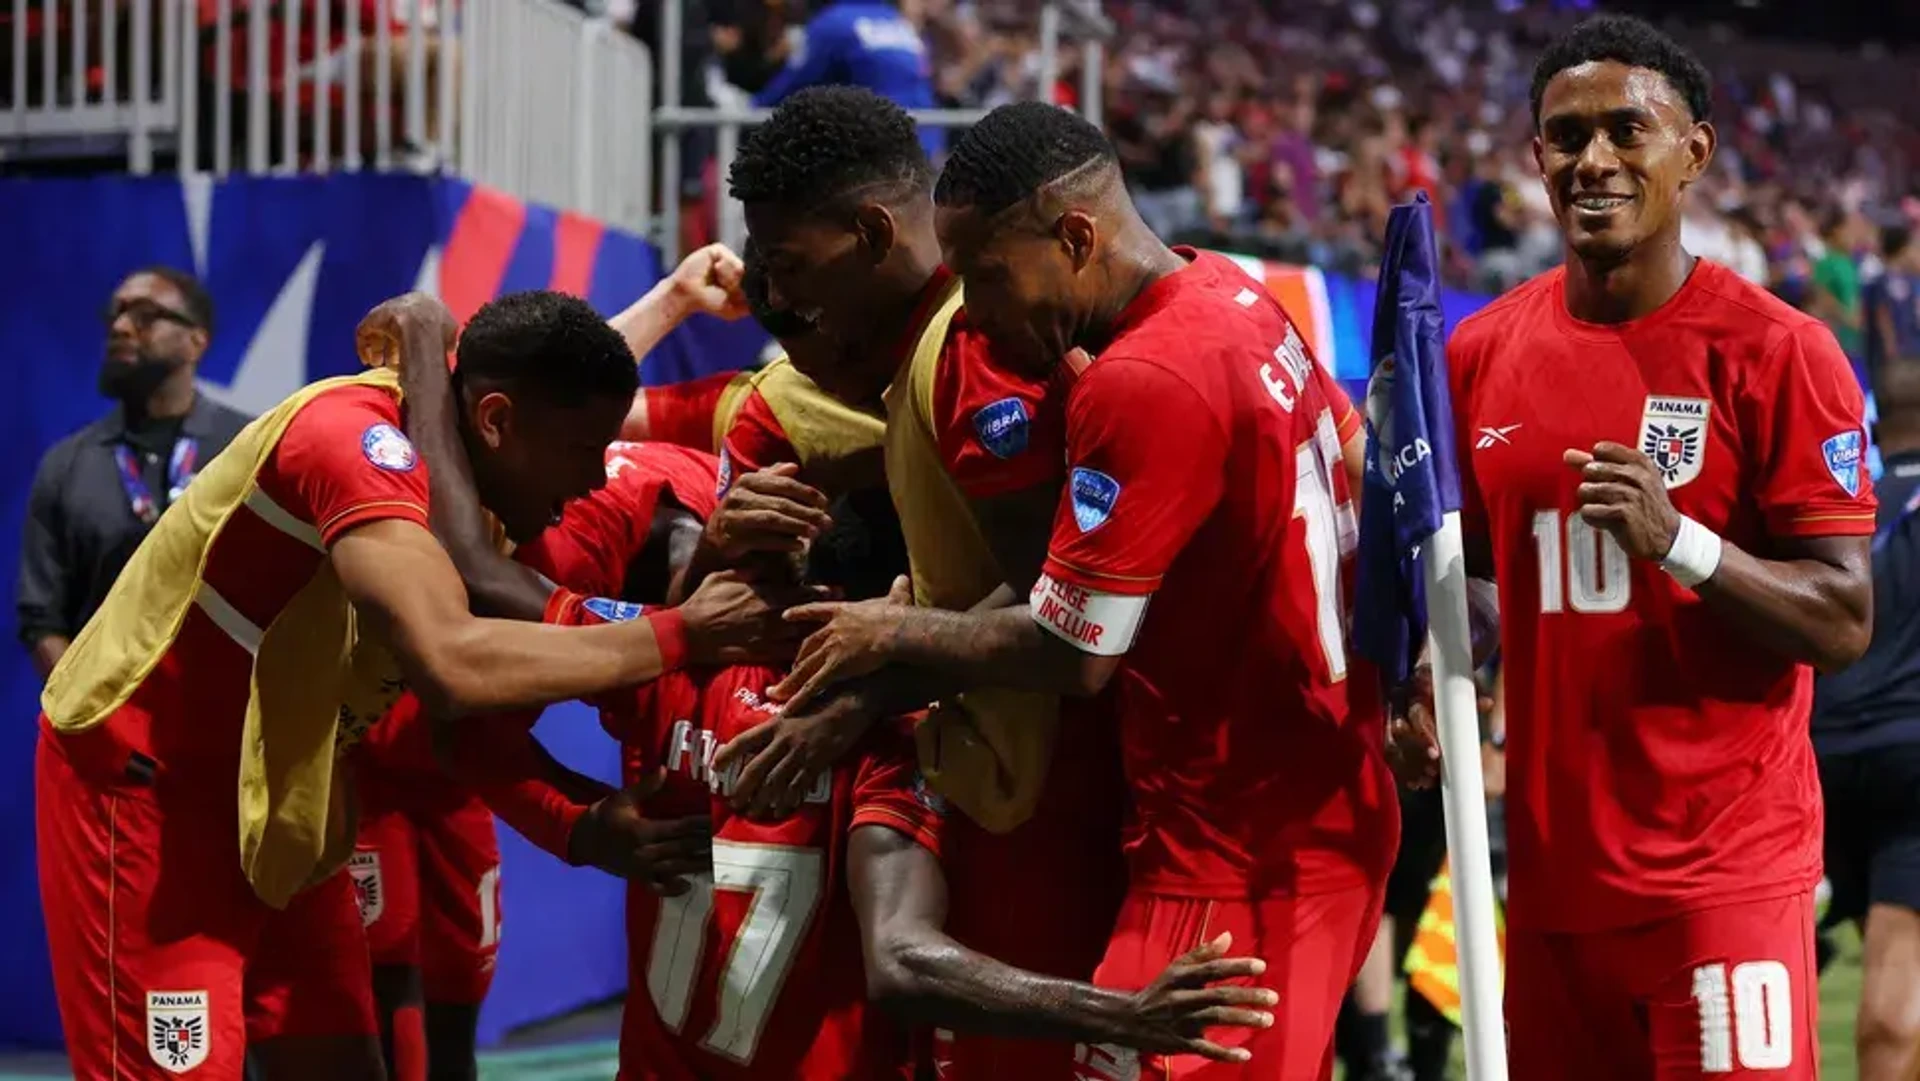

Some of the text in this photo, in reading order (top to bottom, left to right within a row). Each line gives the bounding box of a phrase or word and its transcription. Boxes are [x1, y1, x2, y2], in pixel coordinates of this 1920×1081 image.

[1649, 401, 1703, 415] PANAMA
[1531, 508, 1632, 614] 10
[1038, 595, 1104, 647] INCLUIR
[476, 862, 502, 949] 1
[645, 837, 824, 1067] 17
[151, 995, 202, 1005] PANAMA
[1690, 960, 1793, 1073] 10
